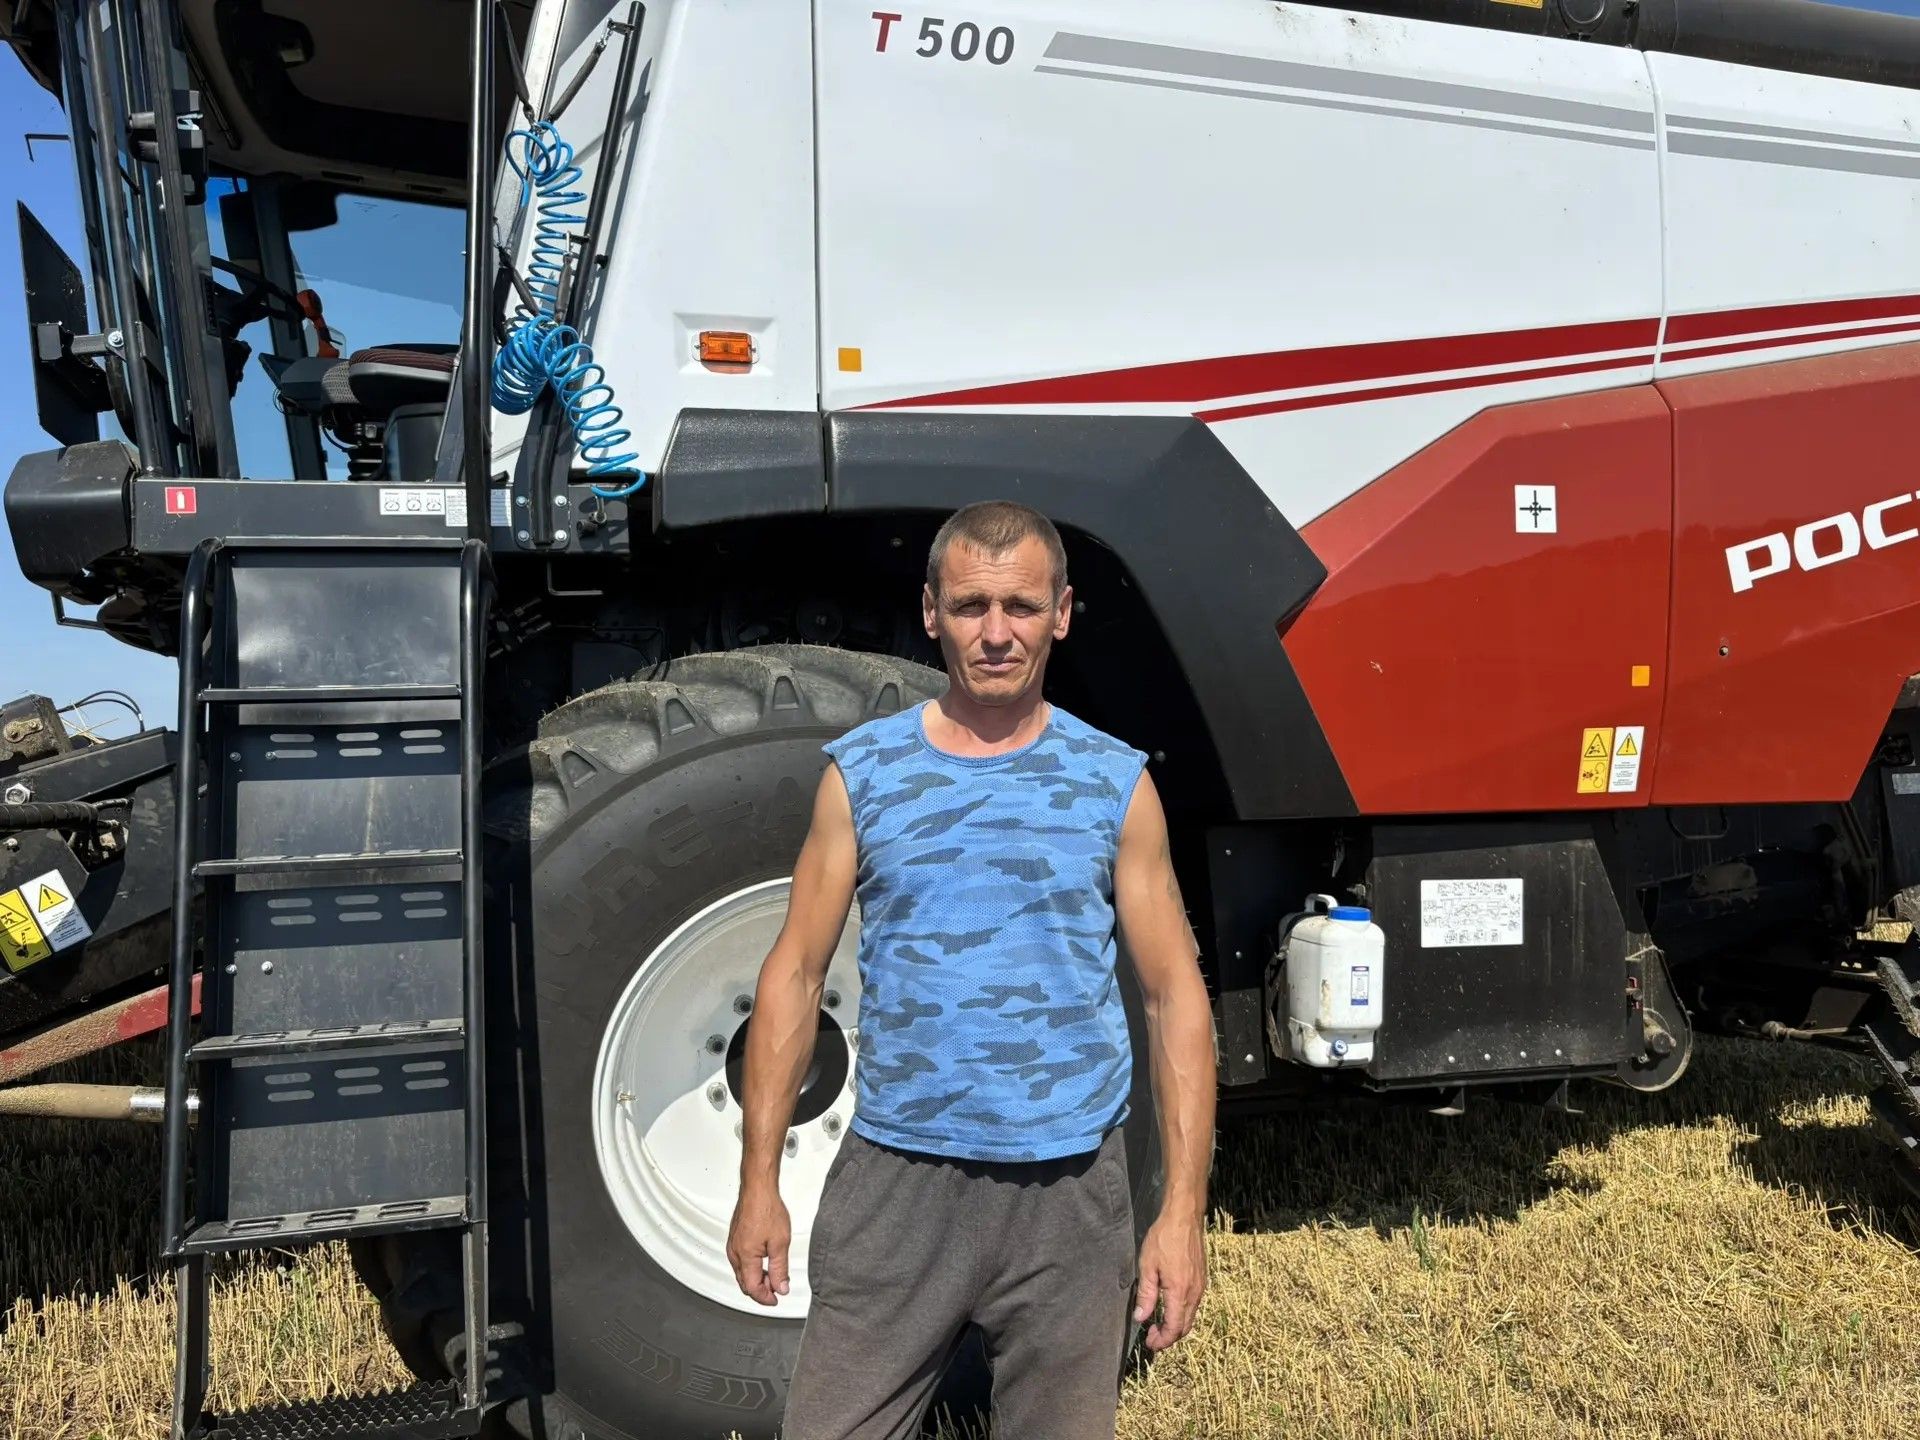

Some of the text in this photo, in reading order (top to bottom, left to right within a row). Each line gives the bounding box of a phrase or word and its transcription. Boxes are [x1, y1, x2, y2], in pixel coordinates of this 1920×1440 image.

[871, 11, 1015, 65] T 500
[1725, 490, 1920, 593] РОС
